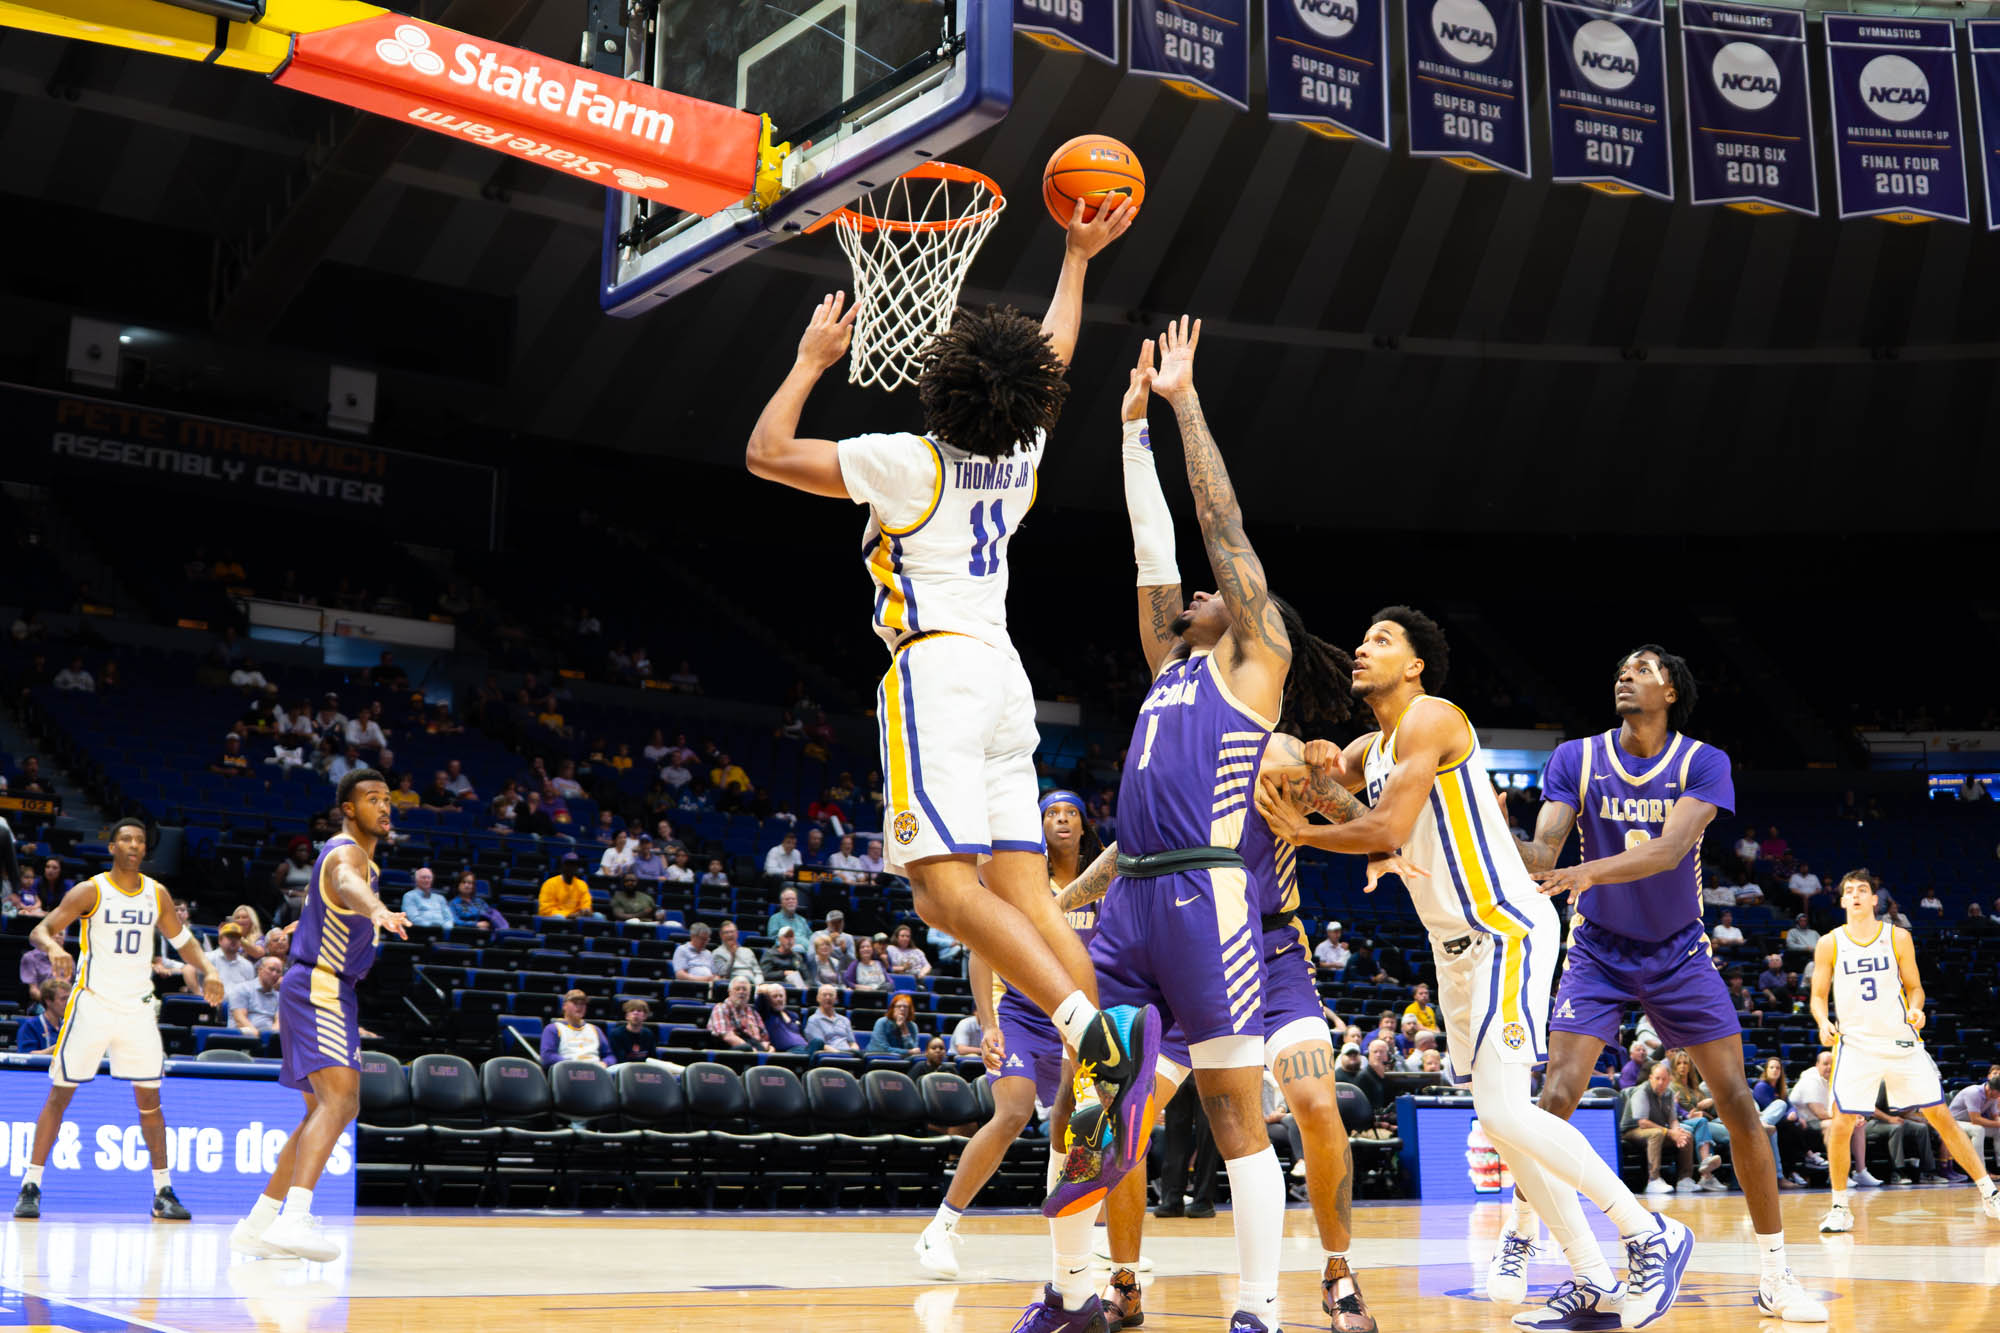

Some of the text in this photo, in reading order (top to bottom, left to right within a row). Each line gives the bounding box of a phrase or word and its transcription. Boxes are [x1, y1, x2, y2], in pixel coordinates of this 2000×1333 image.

[1300, 0, 1356, 25] NCAA
[1711, 10, 1774, 28] GYMNASTICS
[1156, 10, 1224, 46] SUPER SIX
[1440, 21, 1496, 51] NCAA
[1858, 26, 1922, 40] GYMNASTICS
[1164, 33, 1216, 71] 2013
[1581, 50, 1638, 76] NCAA
[1291, 53, 1360, 85] SUPER SIX
[1418, 59, 1514, 90] NATIONAL RUNNER-UP
[1301, 75, 1353, 111] 2014
[1721, 72, 1780, 95] NCAA
[1868, 86, 1929, 105] NCAA
[1433, 91, 1502, 120] SUPER SIX
[1559, 88, 1657, 114] NATIONAL RUNNER-UP
[1443, 112, 1495, 144] 2016
[1575, 118, 1645, 144] SUPER SIX
[1847, 126, 1950, 140] NATIONAL RUNNER-UP
[1090, 148, 1131, 165] LSU
[1586, 139, 1635, 167] 2017
[1716, 142, 1787, 162] SUPER SIX
[1861, 154, 1940, 171] FINAL FOUR
[1726, 160, 1780, 187] 2018
[1875, 173, 1930, 195] 2019
[57, 399, 388, 477] PETE MARAVICH
[52, 431, 386, 507] ASSEMBLY CENTER
[954, 460, 1029, 490] THOMAS JR
[968, 498, 1007, 577] 11
[1137, 713, 1161, 770] 1
[20, 799, 48, 812] 102
[104, 908, 153, 926] LSU
[114, 928, 142, 954] 10
[1843, 956, 1890, 975] LSU
[1859, 977, 1878, 1001] 3
[52, 1121, 82, 1170] &
[235, 1121, 353, 1176] des
